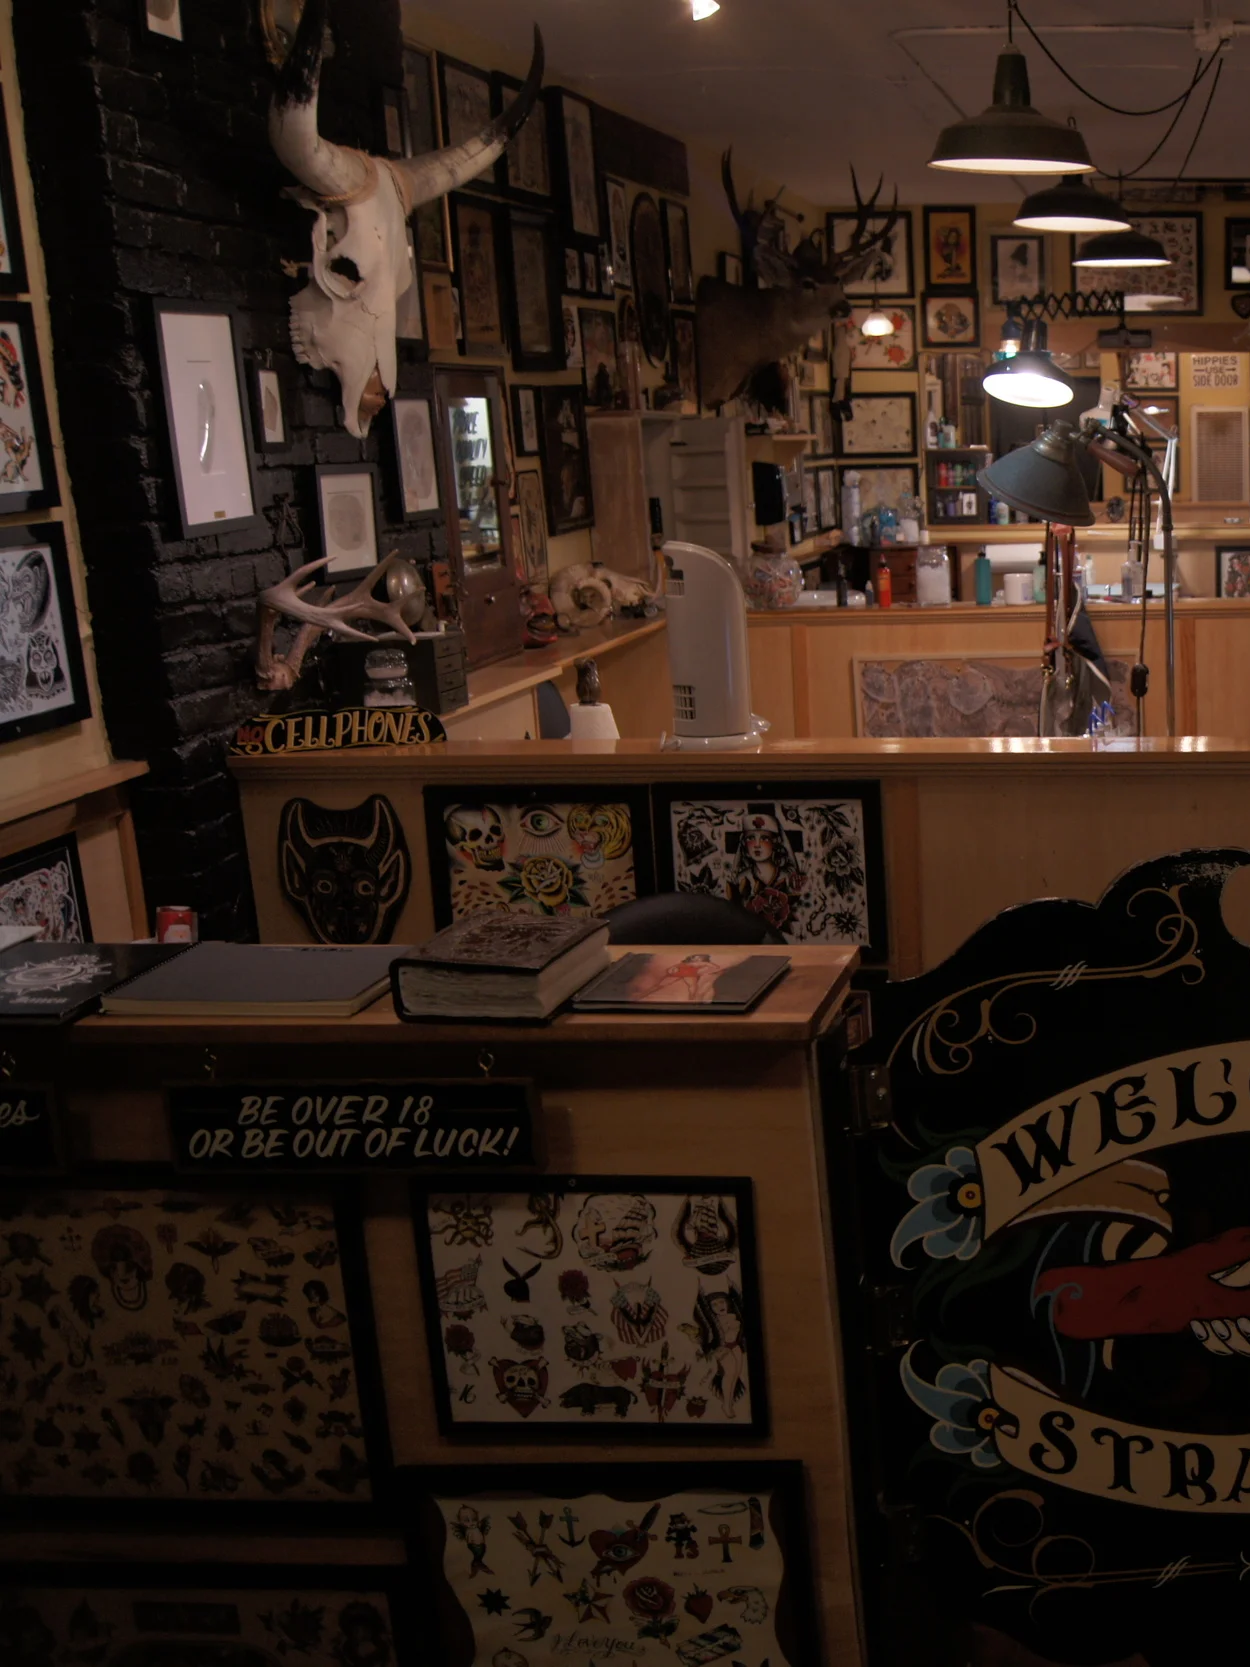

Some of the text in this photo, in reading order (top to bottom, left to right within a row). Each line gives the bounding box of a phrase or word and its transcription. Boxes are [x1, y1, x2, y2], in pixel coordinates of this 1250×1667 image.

[1193, 355, 1237, 366] HIPPIES
[1205, 366, 1224, 374] USE
[1193, 374, 1238, 387] SIDE DOOR
[236, 726, 265, 744] NO
[237, 1094, 434, 1126] BE OVER 18
[188, 1125, 521, 1159] OR BE OUT OF LUCK!
